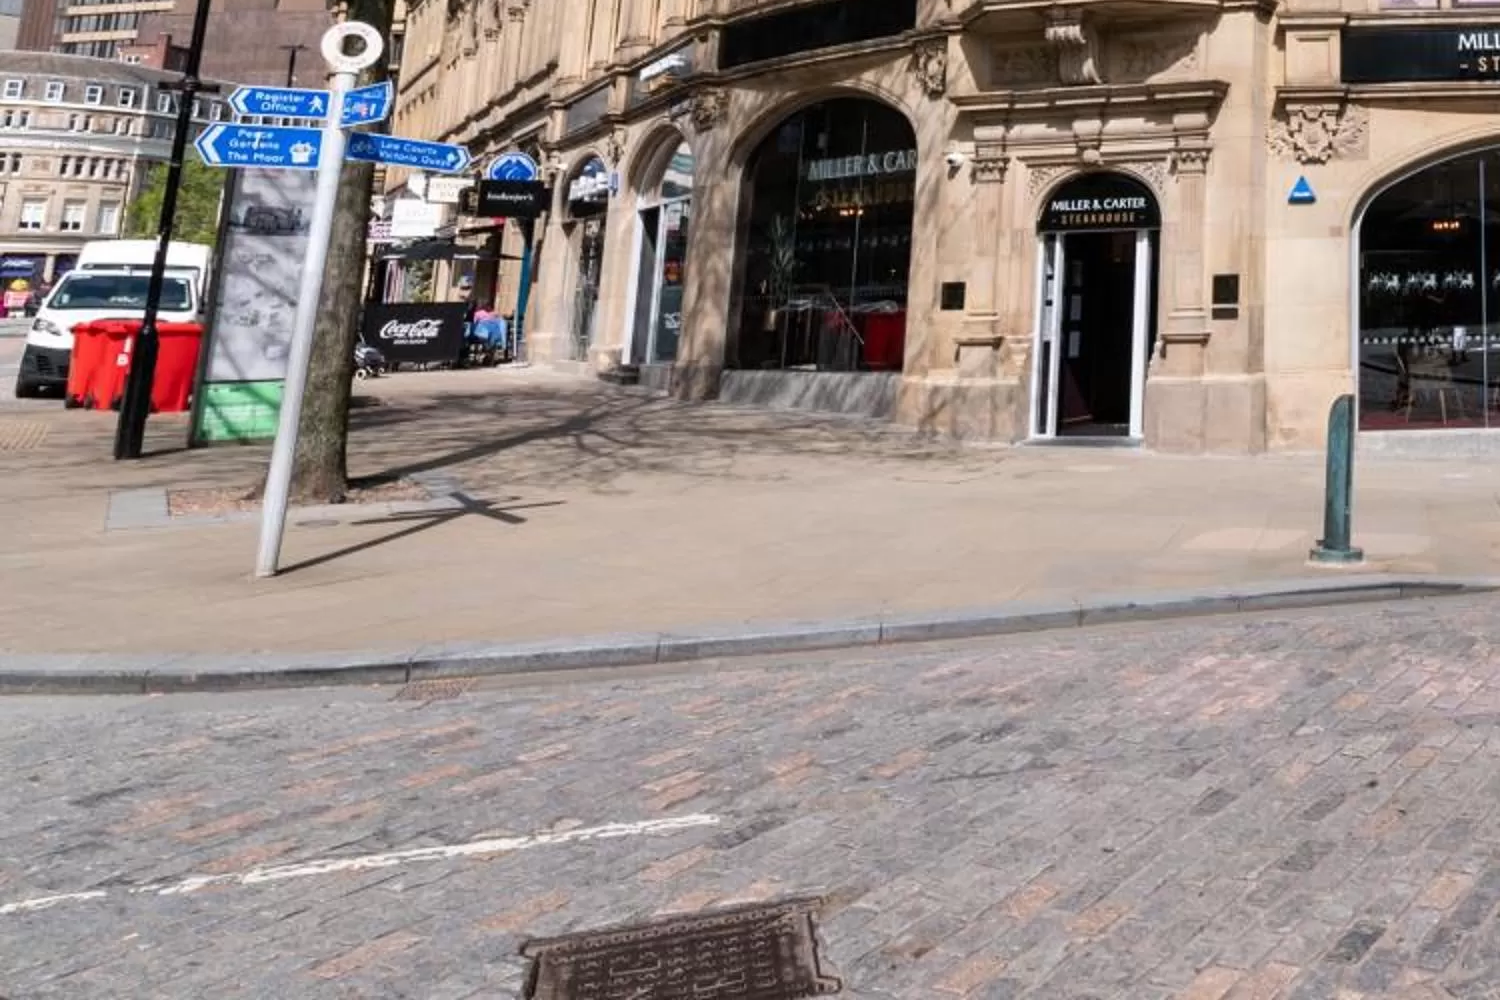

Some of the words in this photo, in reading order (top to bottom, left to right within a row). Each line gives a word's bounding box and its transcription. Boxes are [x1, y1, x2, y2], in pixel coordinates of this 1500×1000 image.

[255, 91, 306, 103] Register
[261, 101, 297, 112] Office
[227, 151, 249, 161] The
[253, 152, 285, 163] Moor
[807, 155, 862, 181] MILLER
[867, 152, 879, 175] &
[1051, 199, 1090, 211] MILLER
[1092, 199, 1102, 210] &
[1103, 197, 1146, 209] CARTER
[1061, 211, 1136, 225] STEAKHOUSE
